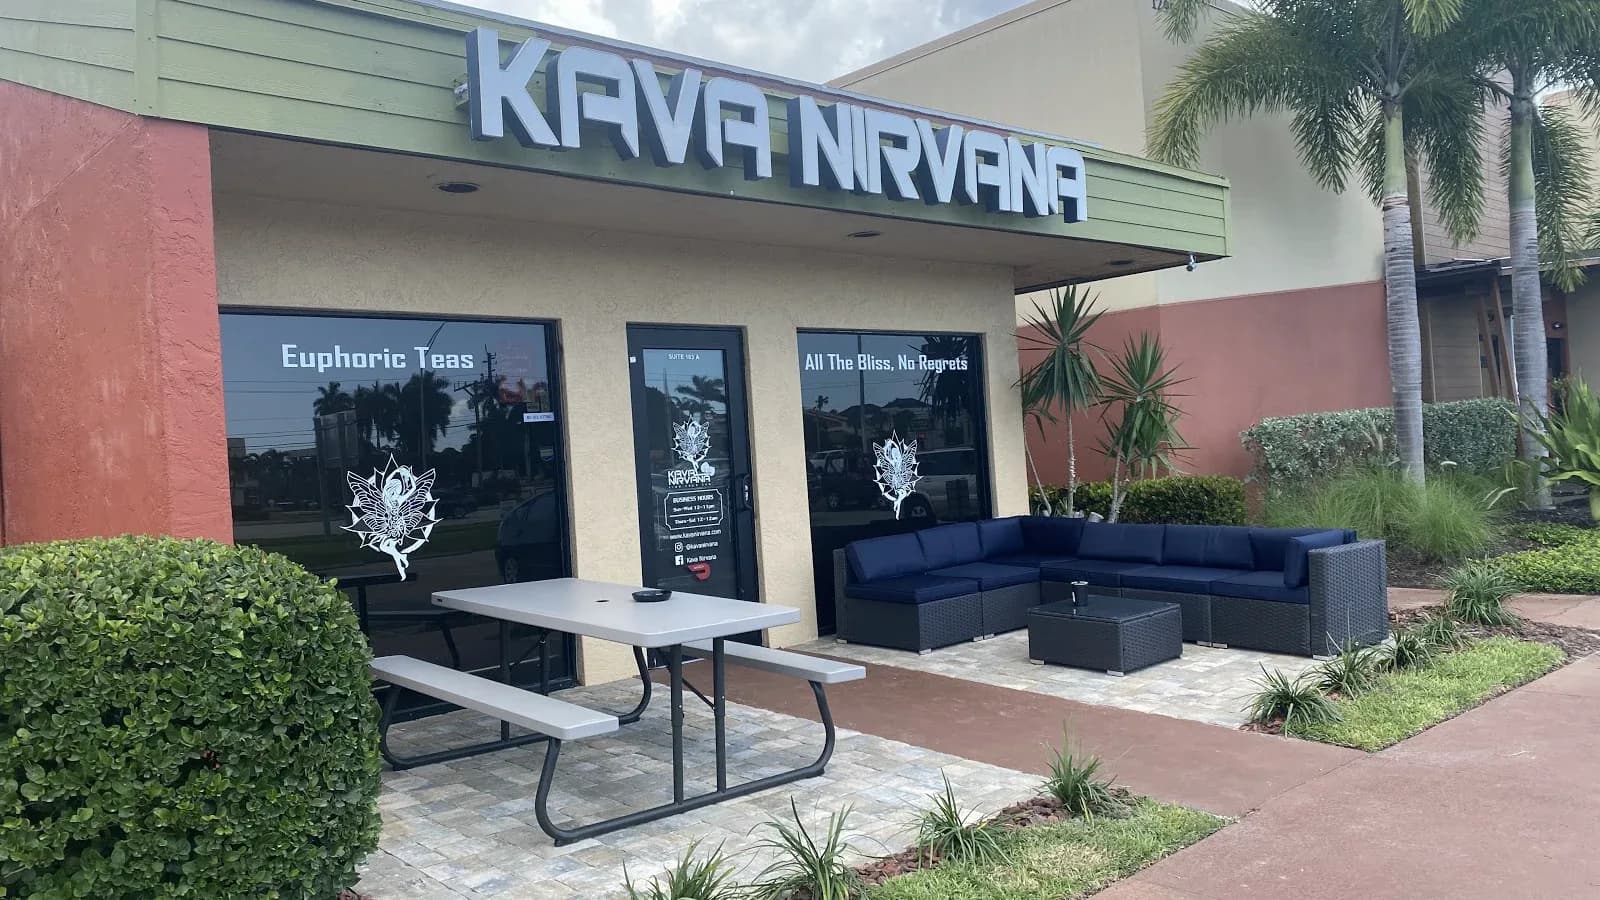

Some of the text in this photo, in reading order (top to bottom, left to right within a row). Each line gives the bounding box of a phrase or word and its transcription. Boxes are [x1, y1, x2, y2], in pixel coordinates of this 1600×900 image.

[467, 26, 1089, 223] KAVA NIRVANA
[281, 343, 474, 373] Euphoric Teas
[804, 353, 968, 374] All The Bliss, No Regrets
[668, 469, 695, 478] KAVA
[668, 475, 711, 485] NIRVANA
[673, 494, 714, 503] BUSINESS HOURS
